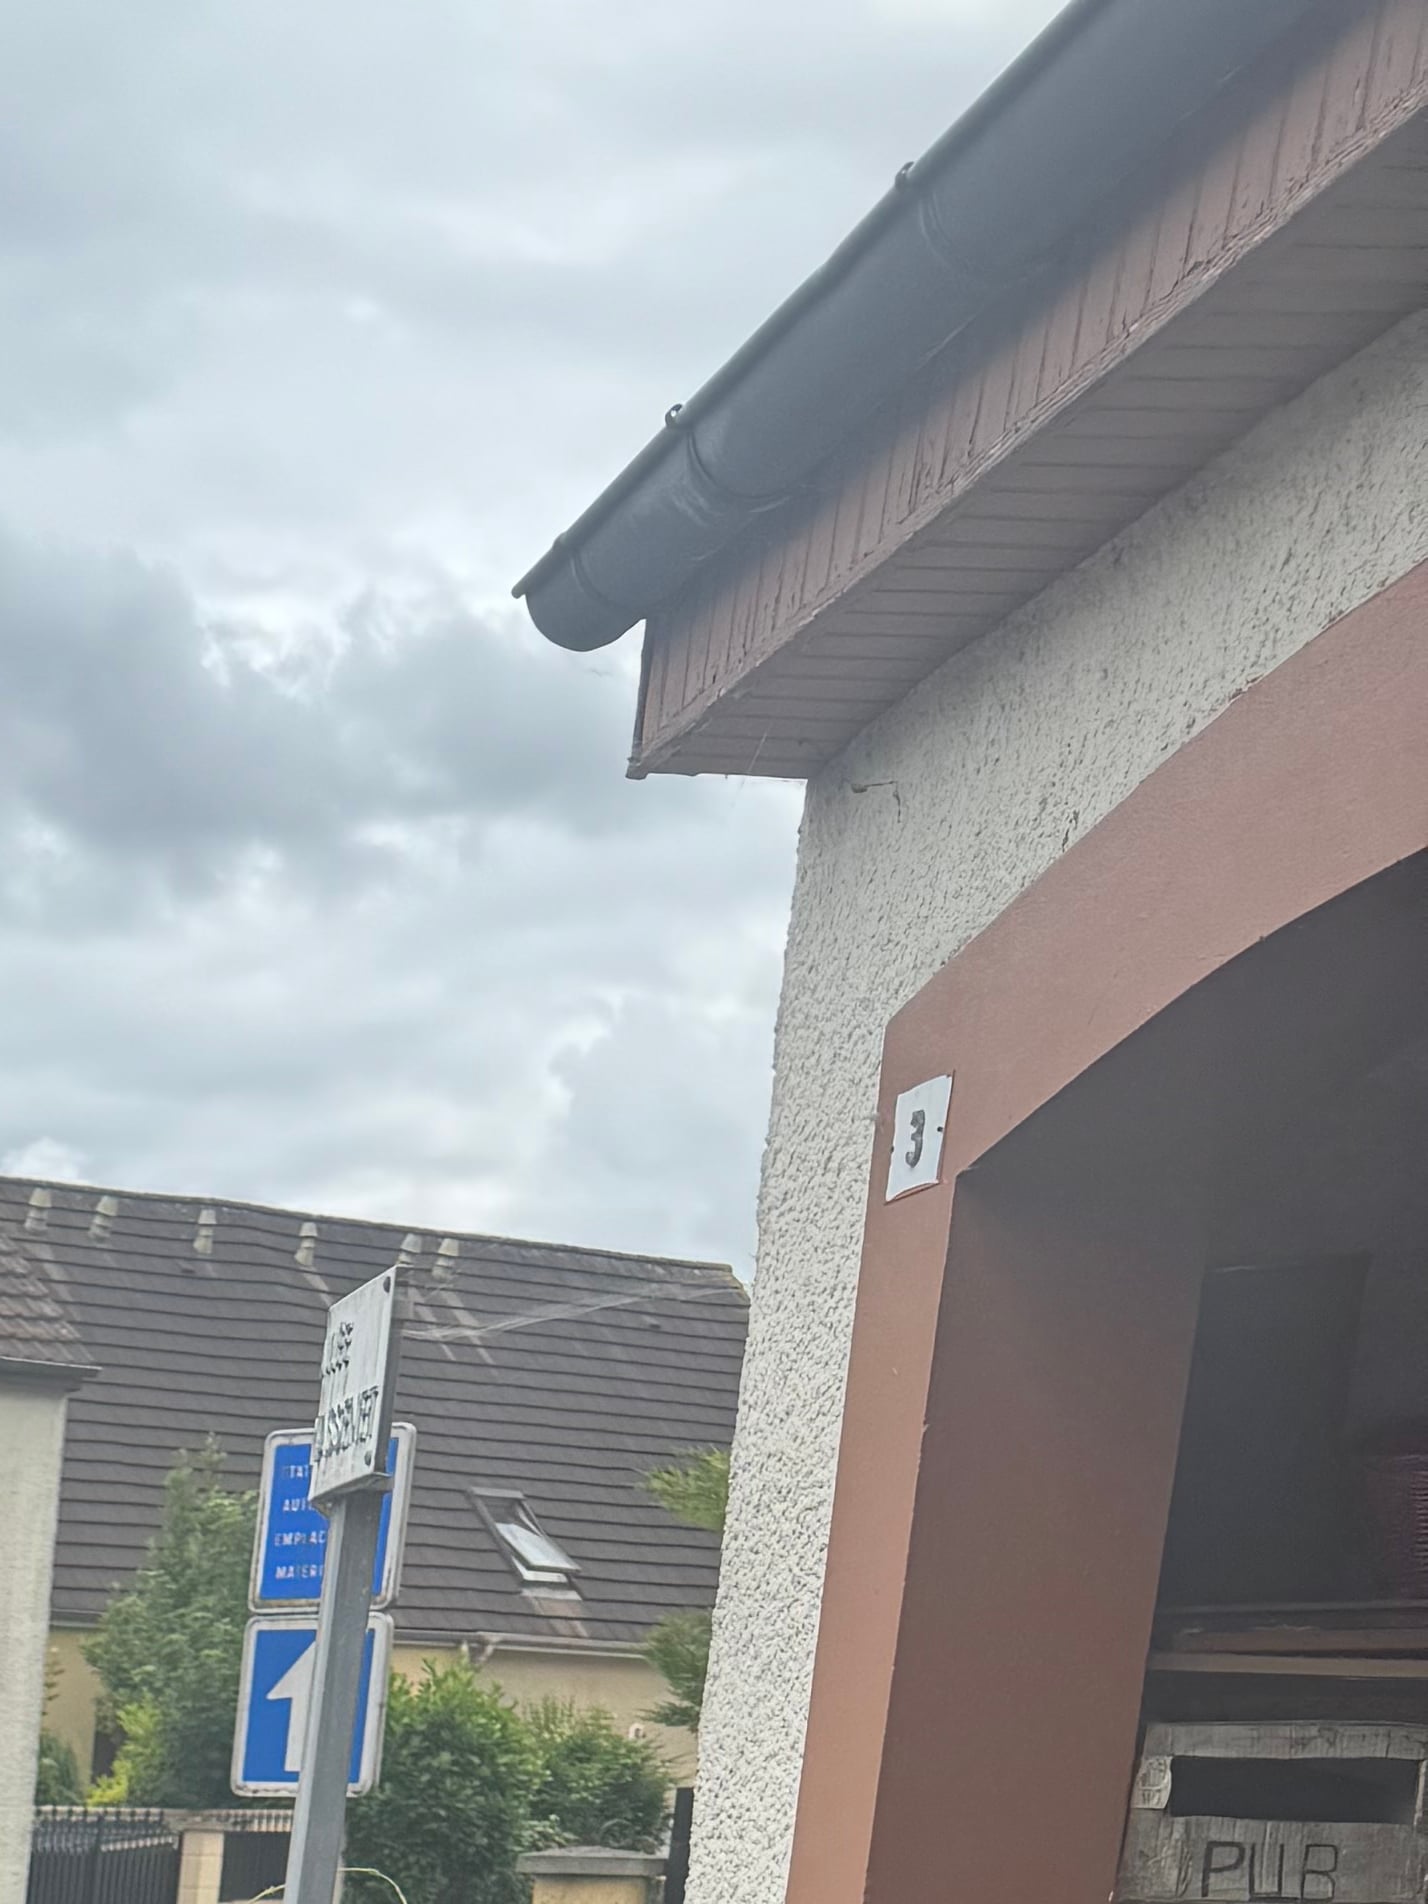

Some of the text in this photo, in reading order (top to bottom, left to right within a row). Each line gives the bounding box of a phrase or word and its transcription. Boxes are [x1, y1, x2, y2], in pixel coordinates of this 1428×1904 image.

[905, 1109, 926, 1169] 3
[274, 1530, 327, 1546] EMPLAC
[1199, 1839, 1339, 1901] PUB
